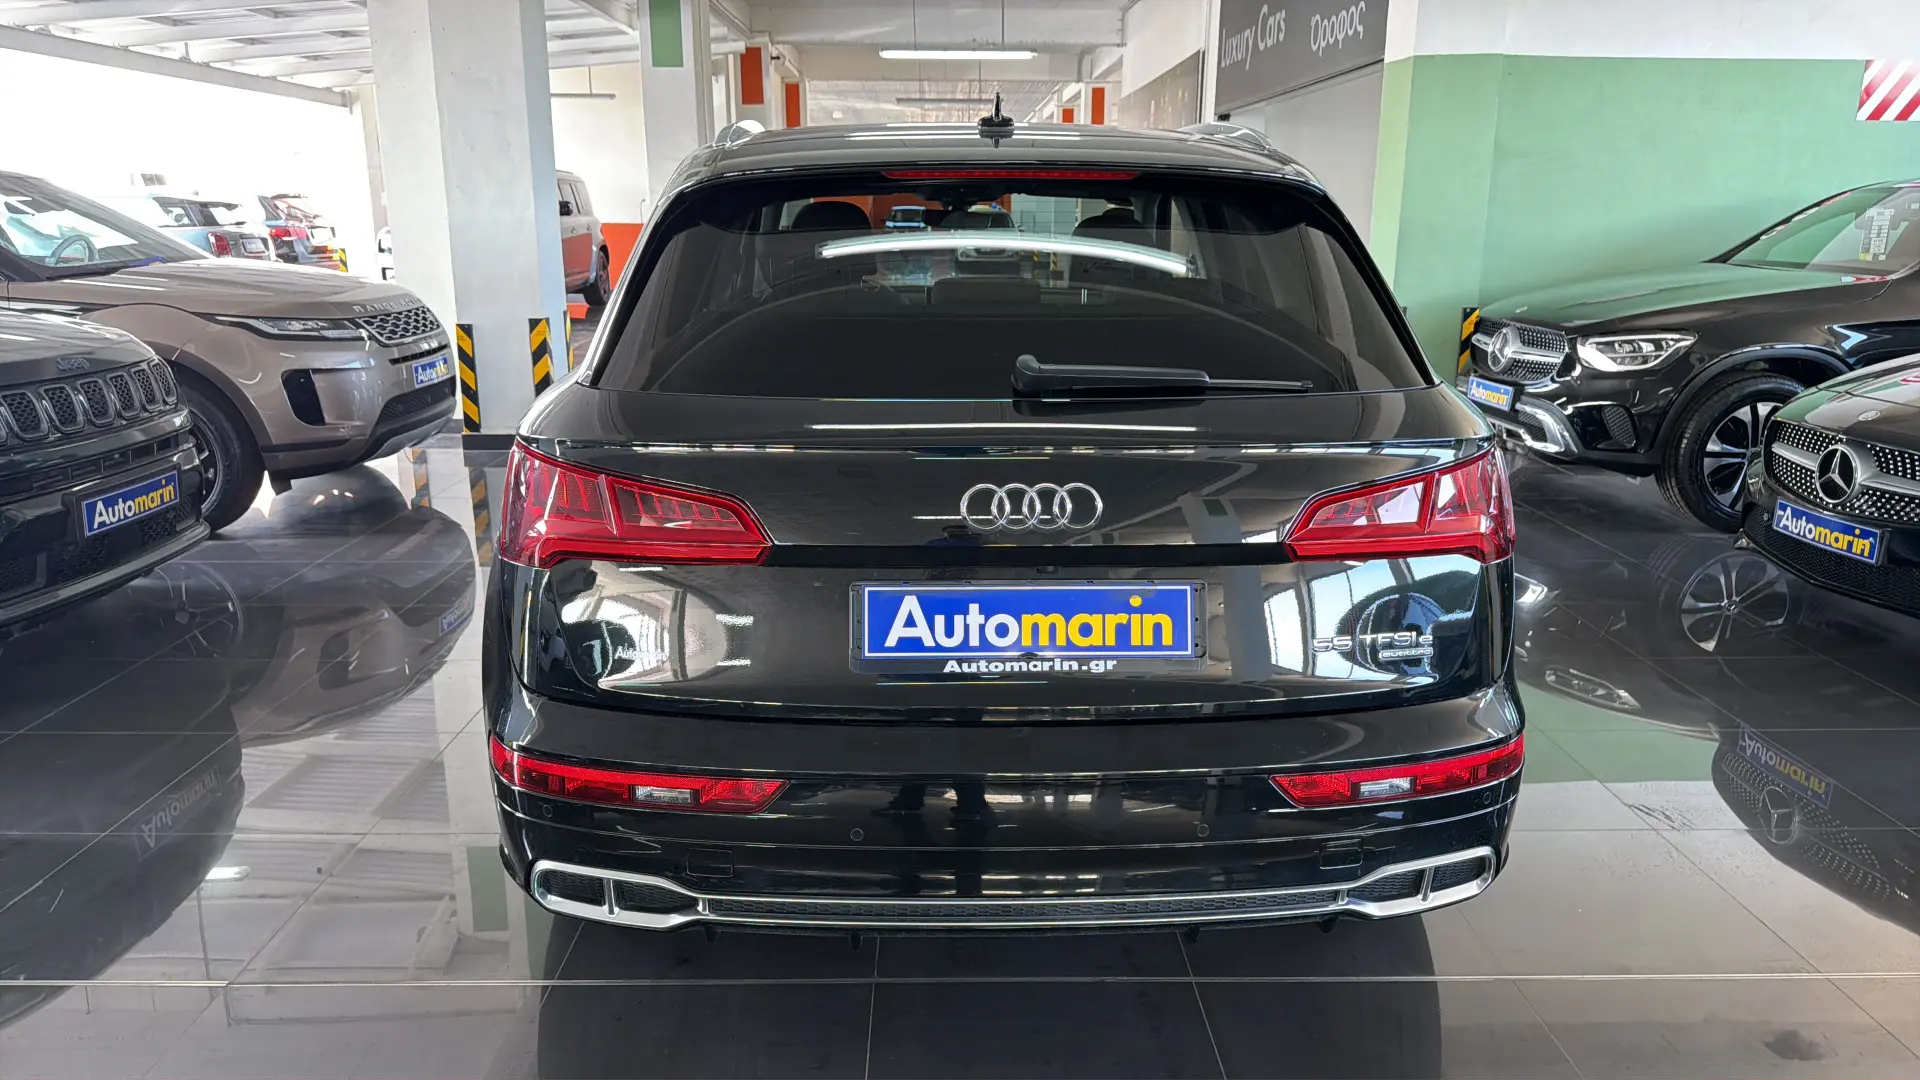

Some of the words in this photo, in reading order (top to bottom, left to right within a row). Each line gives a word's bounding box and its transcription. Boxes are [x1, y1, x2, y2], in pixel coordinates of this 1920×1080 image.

[1221, 27, 1255, 71] Luxury
[1257, 4, 1286, 51] Cars
[93, 479, 175, 529] Automarin
[1779, 506, 1870, 557] Automarin
[884, 595, 1173, 647] Automarin
[1312, 636, 1352, 652] 55
[943, 658, 1117, 674] Automarin.gr
